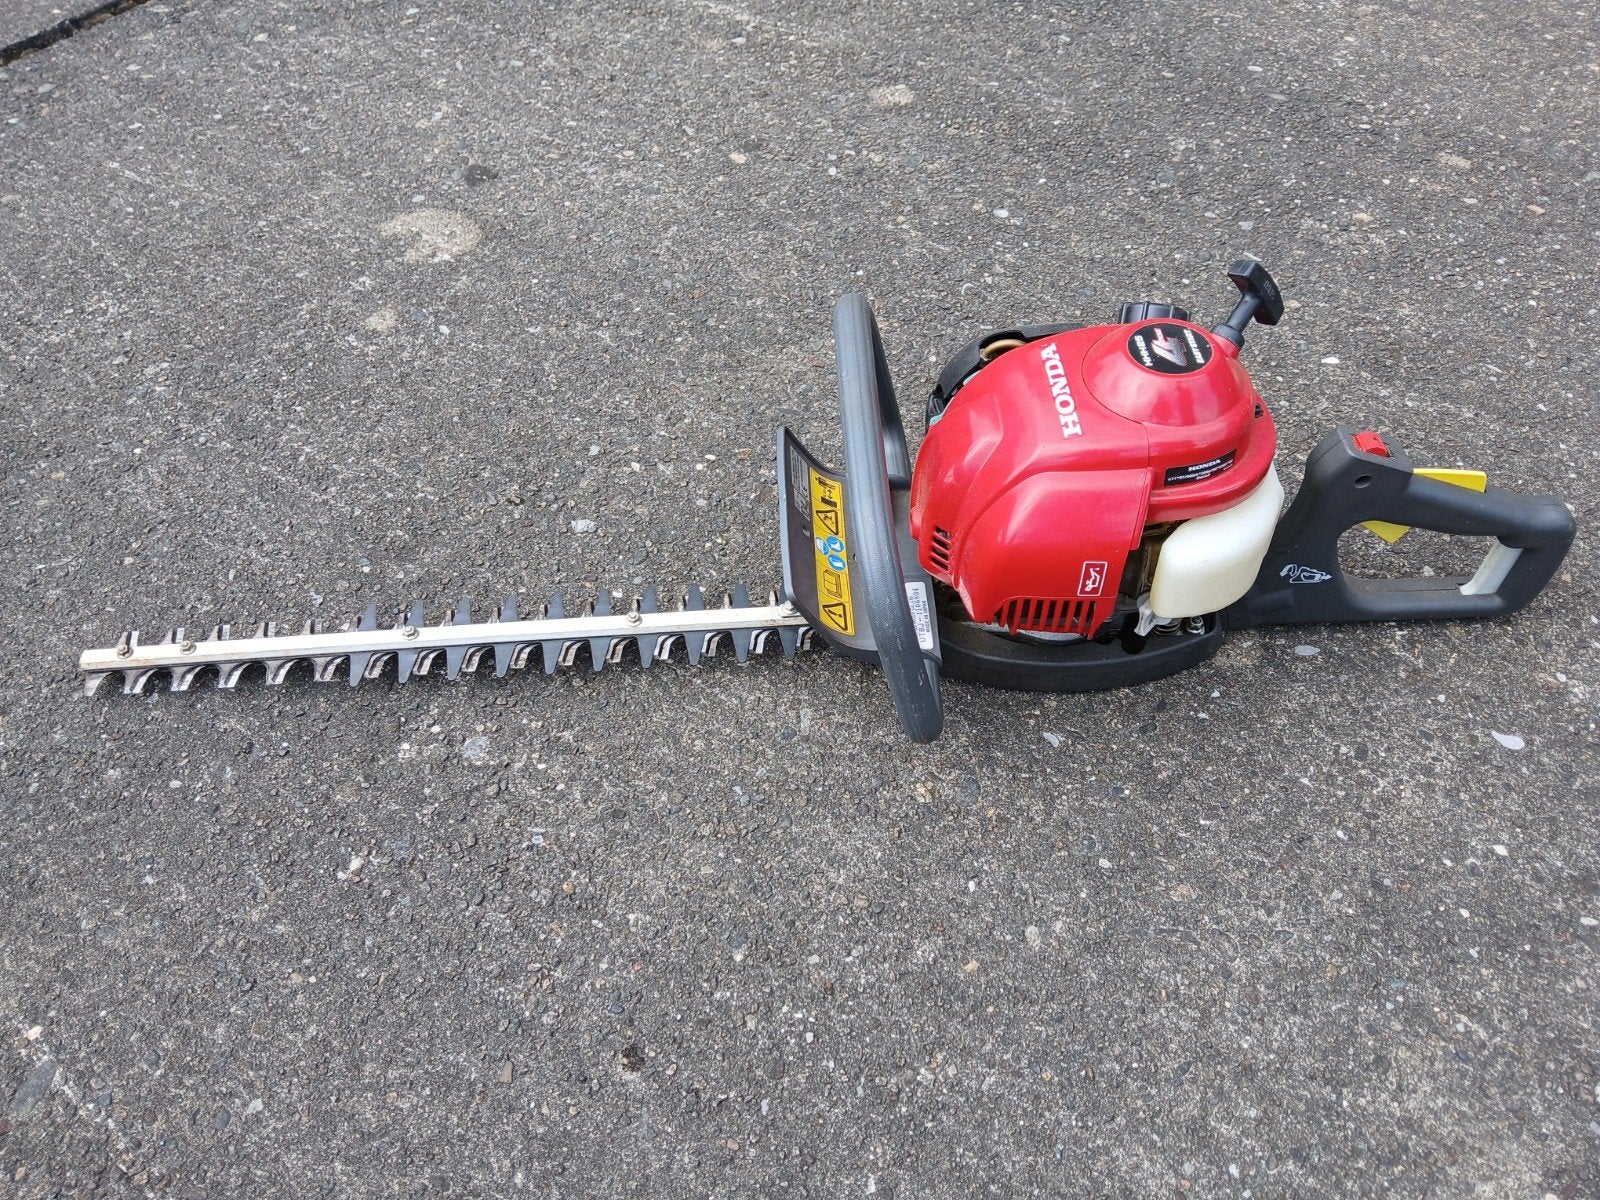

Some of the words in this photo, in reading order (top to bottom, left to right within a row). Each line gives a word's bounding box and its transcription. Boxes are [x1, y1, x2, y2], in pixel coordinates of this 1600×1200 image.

[1134, 335, 1153, 367] HHH25
[1040, 342, 1083, 438] HONDA
[1188, 459, 1221, 472] HONDA
